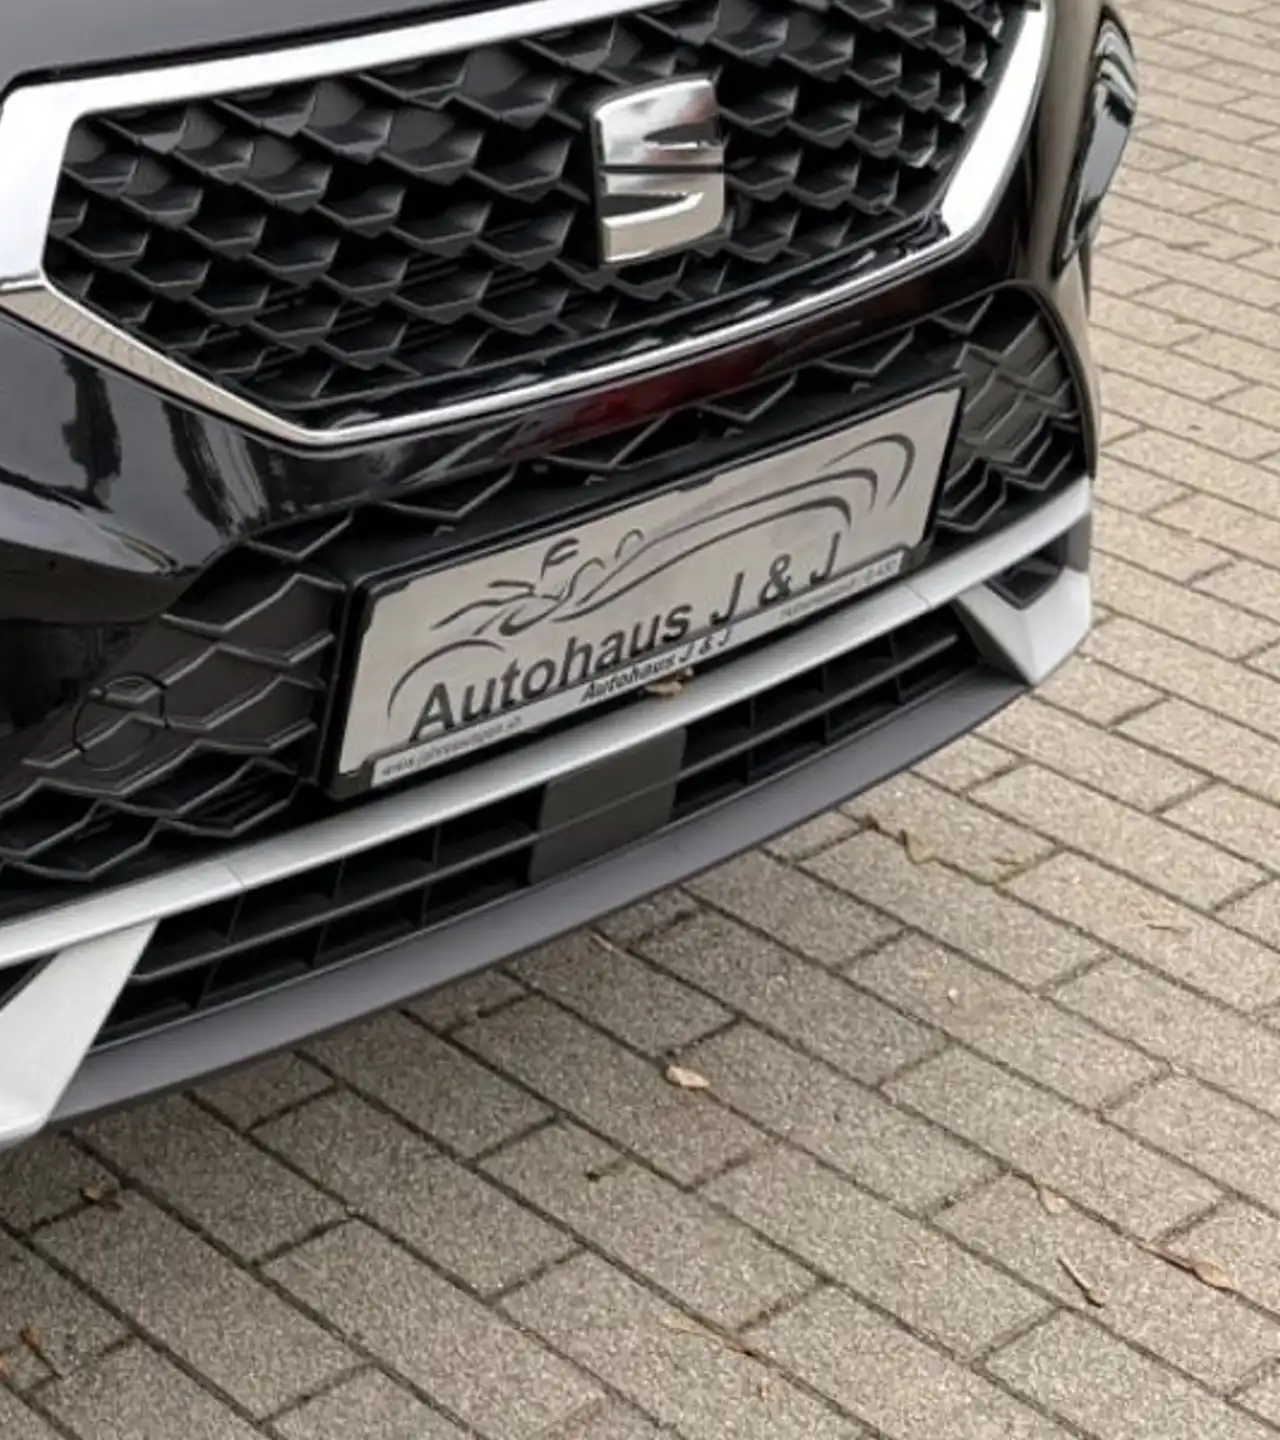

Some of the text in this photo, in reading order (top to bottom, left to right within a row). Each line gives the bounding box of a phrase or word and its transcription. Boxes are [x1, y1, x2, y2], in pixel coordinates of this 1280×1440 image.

[407, 603, 694, 744] Autohaus
[709, 572, 744, 627] J
[758, 553, 792, 608] &
[809, 531, 841, 585] J
